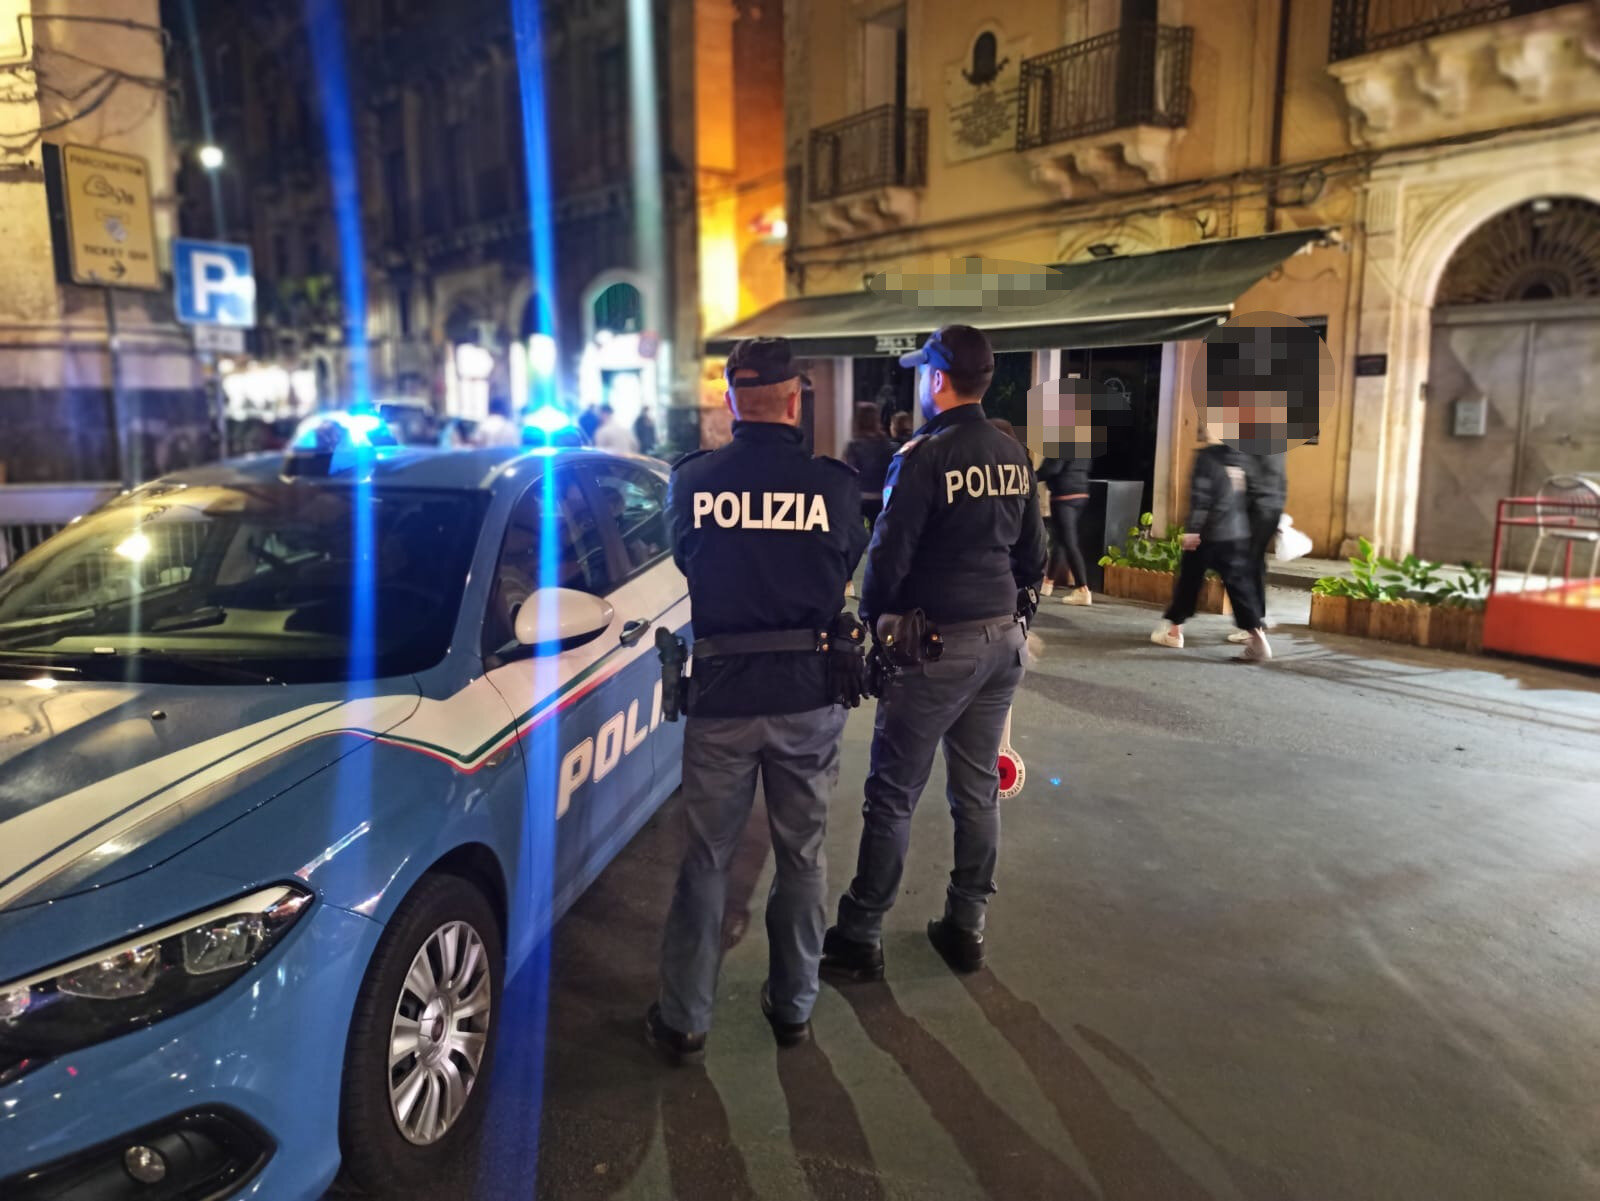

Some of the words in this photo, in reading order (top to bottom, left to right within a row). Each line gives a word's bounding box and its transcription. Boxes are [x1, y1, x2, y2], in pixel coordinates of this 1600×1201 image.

[190, 250, 236, 314] P
[944, 464, 1030, 504] POLIZIA
[693, 491, 830, 532] POLIZIA
[555, 655, 692, 820] POLI
